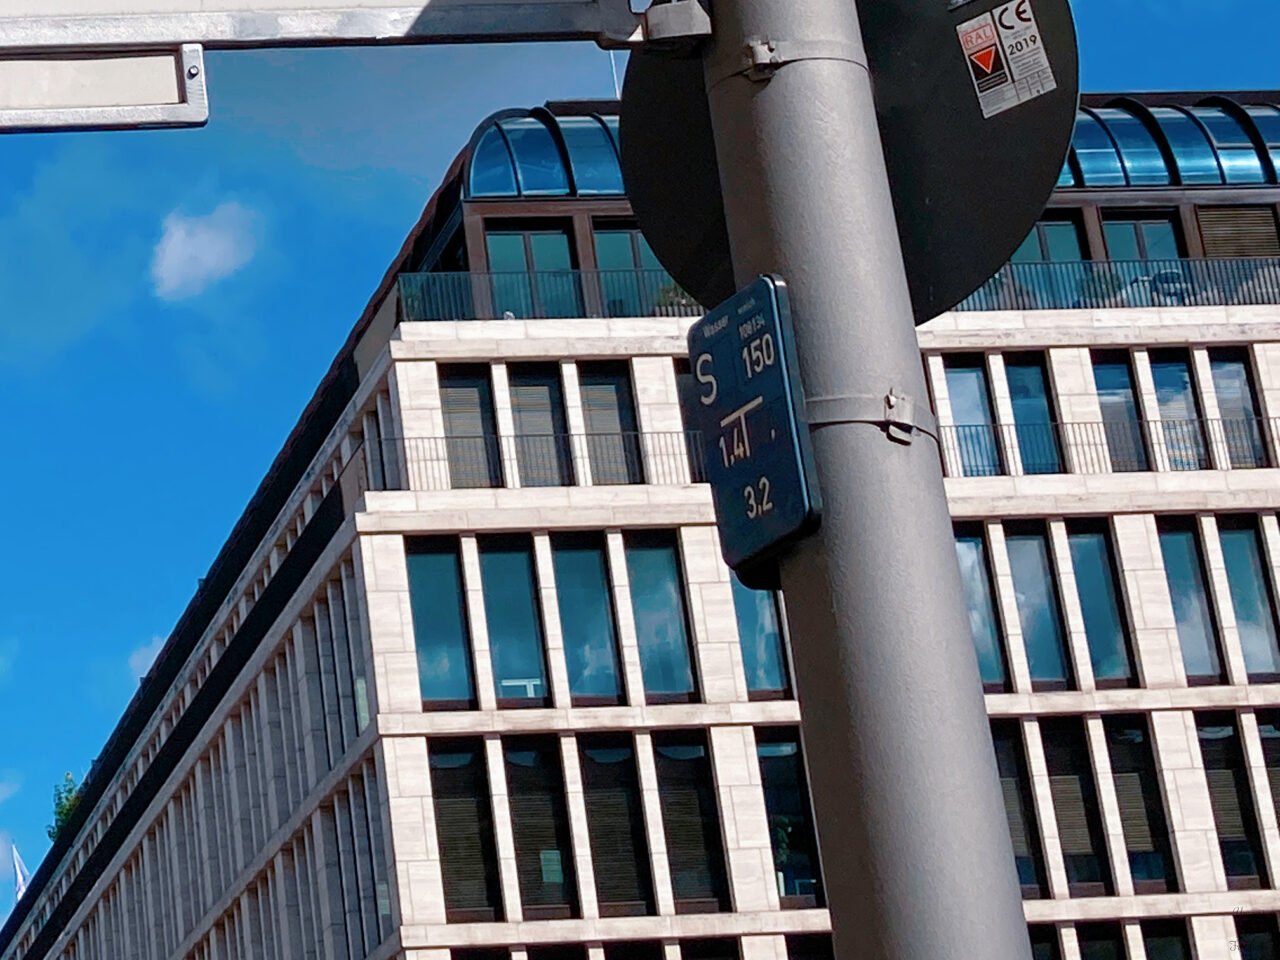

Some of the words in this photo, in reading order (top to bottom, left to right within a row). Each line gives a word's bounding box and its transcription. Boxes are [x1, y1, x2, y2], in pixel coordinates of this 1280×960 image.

[964, 28, 992, 47] RAL
[1008, 34, 1038, 56] 2019
[742, 333, 775, 379] 150
[696, 352, 718, 406] S
